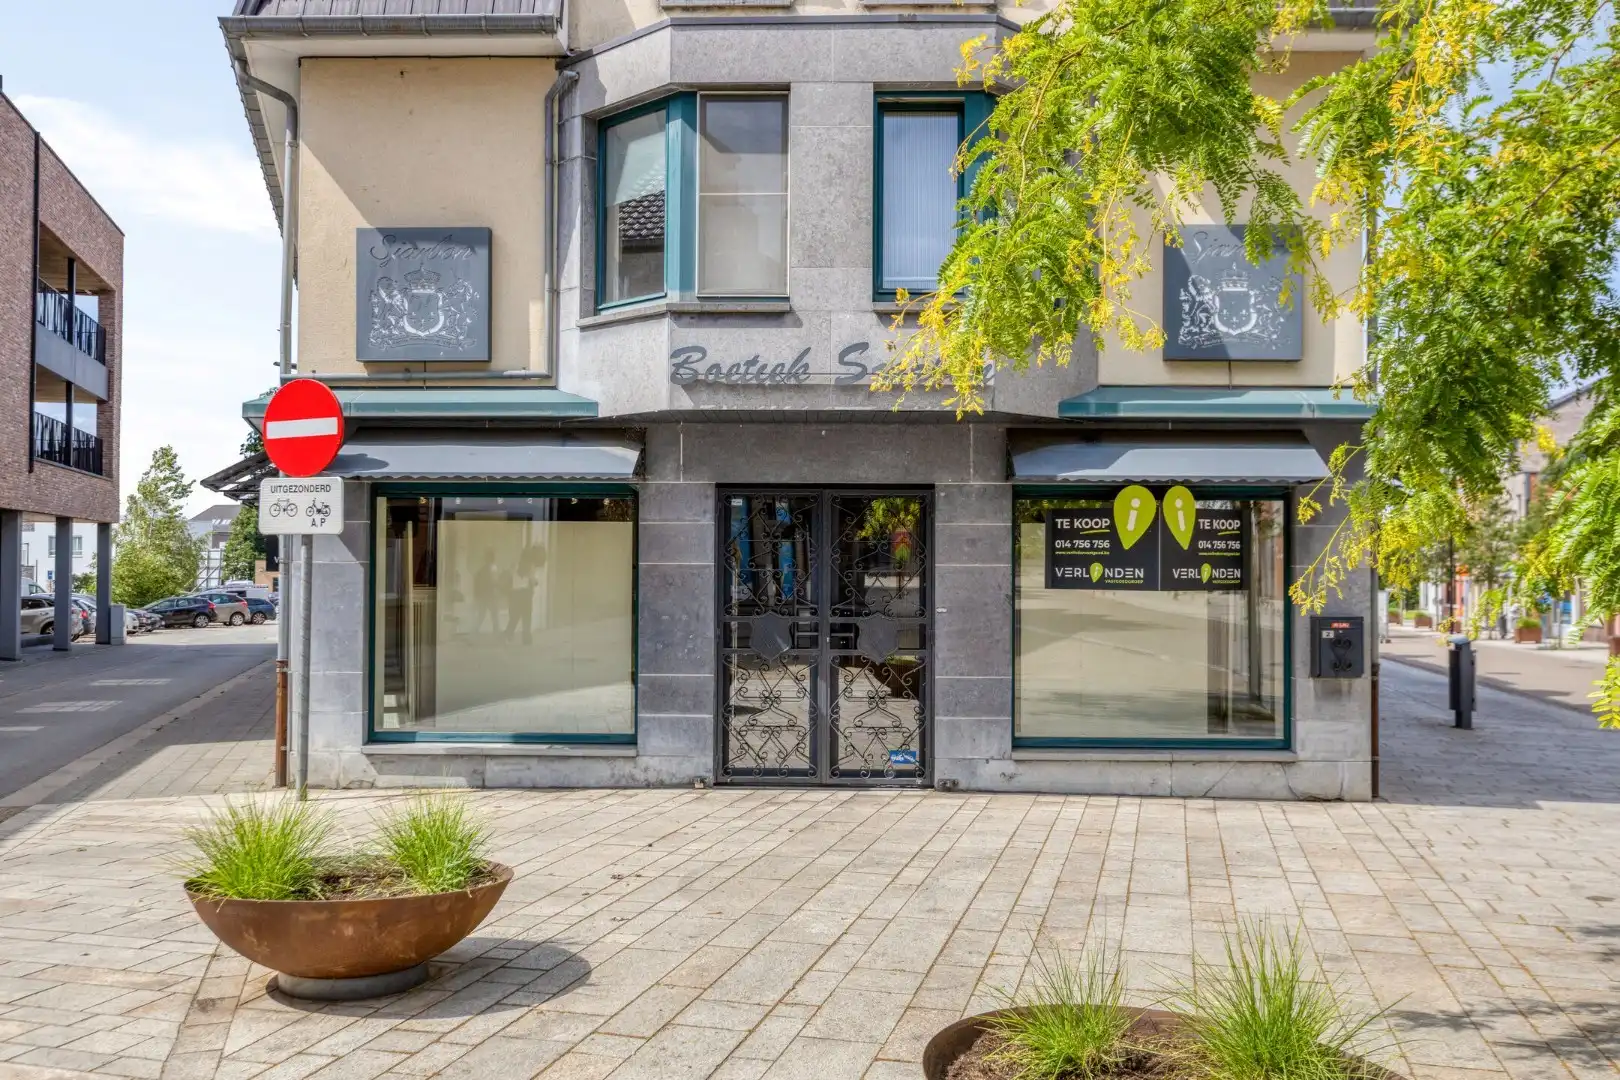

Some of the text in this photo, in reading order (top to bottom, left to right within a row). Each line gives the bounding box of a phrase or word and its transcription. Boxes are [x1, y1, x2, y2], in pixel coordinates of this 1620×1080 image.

[270, 484, 332, 494] UITGEZONDERD
[320, 518, 326, 527] P
[1055, 518, 1111, 529] TE KOOP
[1198, 518, 1240, 530] TE KOOP
[1055, 540, 1110, 549] 014 756 756
[1198, 540, 1240, 549] 014 756 756
